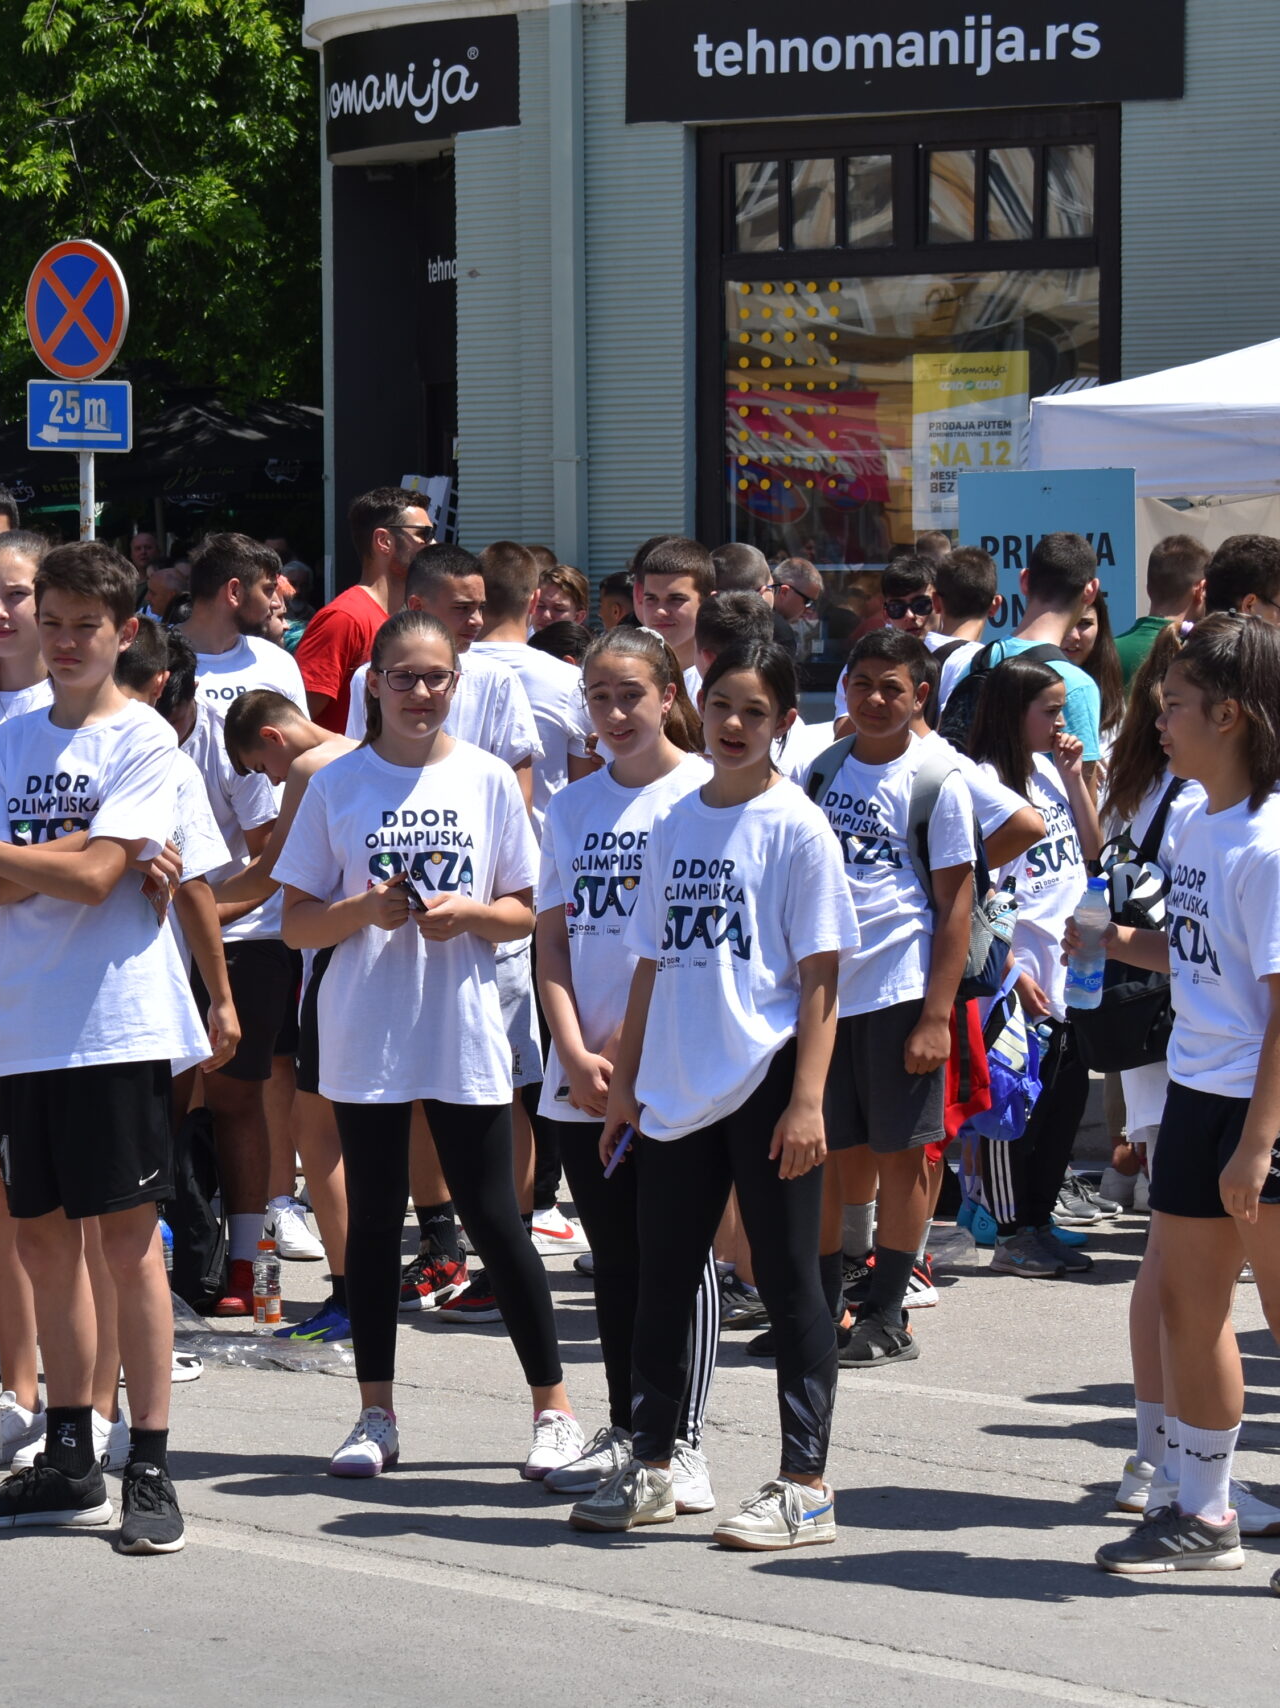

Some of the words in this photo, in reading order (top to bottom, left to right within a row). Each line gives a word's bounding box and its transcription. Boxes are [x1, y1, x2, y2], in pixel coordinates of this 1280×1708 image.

[694, 15, 1101, 78] tehnomanija.rs
[49, 389, 81, 424] 25
[85, 398, 108, 425] m
[929, 422, 975, 432] PRODAJA
[977, 420, 1012, 430] PUTEM
[930, 441, 972, 467] NA
[980, 440, 1012, 466] 12
[930, 471, 958, 481] MESE
[930, 482, 956, 493] BEZ
[824, 791, 882, 820] DDOR
[381, 809, 459, 828] DDOR
[828, 810, 890, 838] IMPIJSKA
[364, 830, 475, 850] OLIMPIJSKA
[572, 853, 644, 873] OLIMPIJS
[672, 859, 736, 880] DDOR
